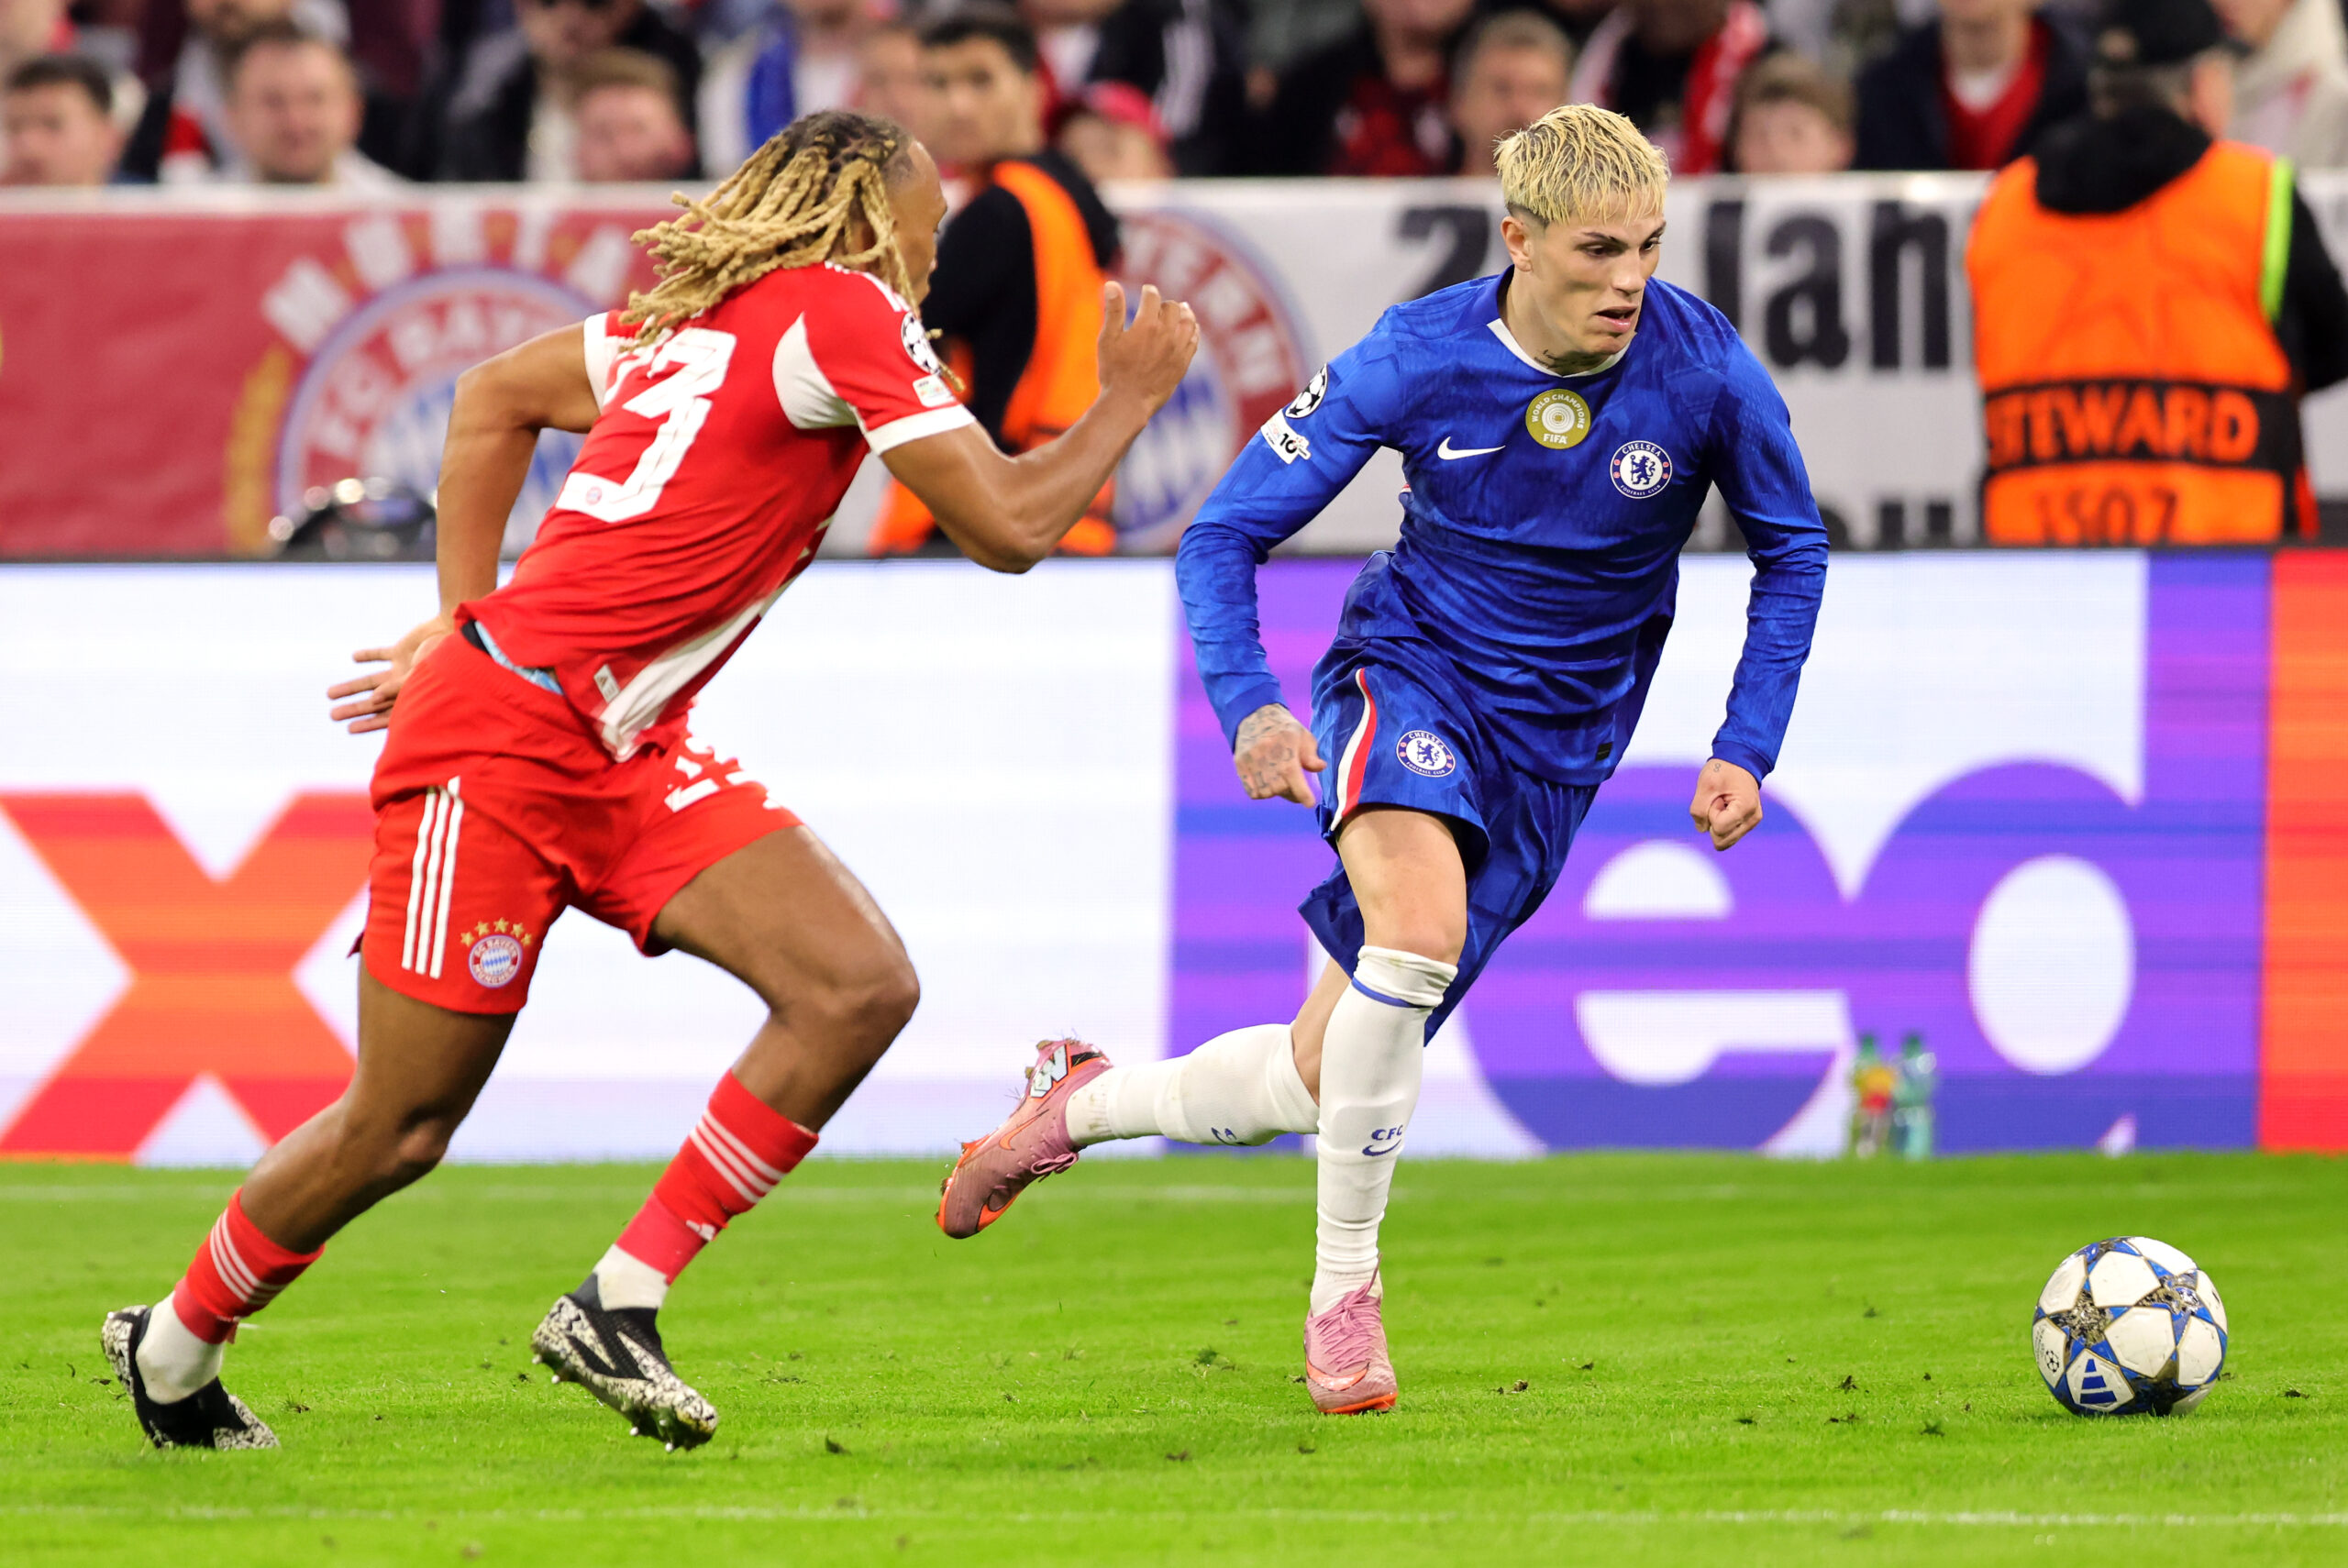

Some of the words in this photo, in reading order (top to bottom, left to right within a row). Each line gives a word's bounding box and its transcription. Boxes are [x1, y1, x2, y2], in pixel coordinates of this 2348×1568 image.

[1532, 397, 1551, 423] WORLD
[1551, 393, 1586, 430] CHAMPIONS
[1543, 433, 1567, 445] FIFA
[1622, 442, 1662, 458] CHELSEA
[1620, 484, 1646, 496] FOOTBALL
[1647, 484, 1662, 494] CLUB
[1408, 732, 1445, 749] CHELSEA
[1371, 1124, 1403, 1141] CFC
